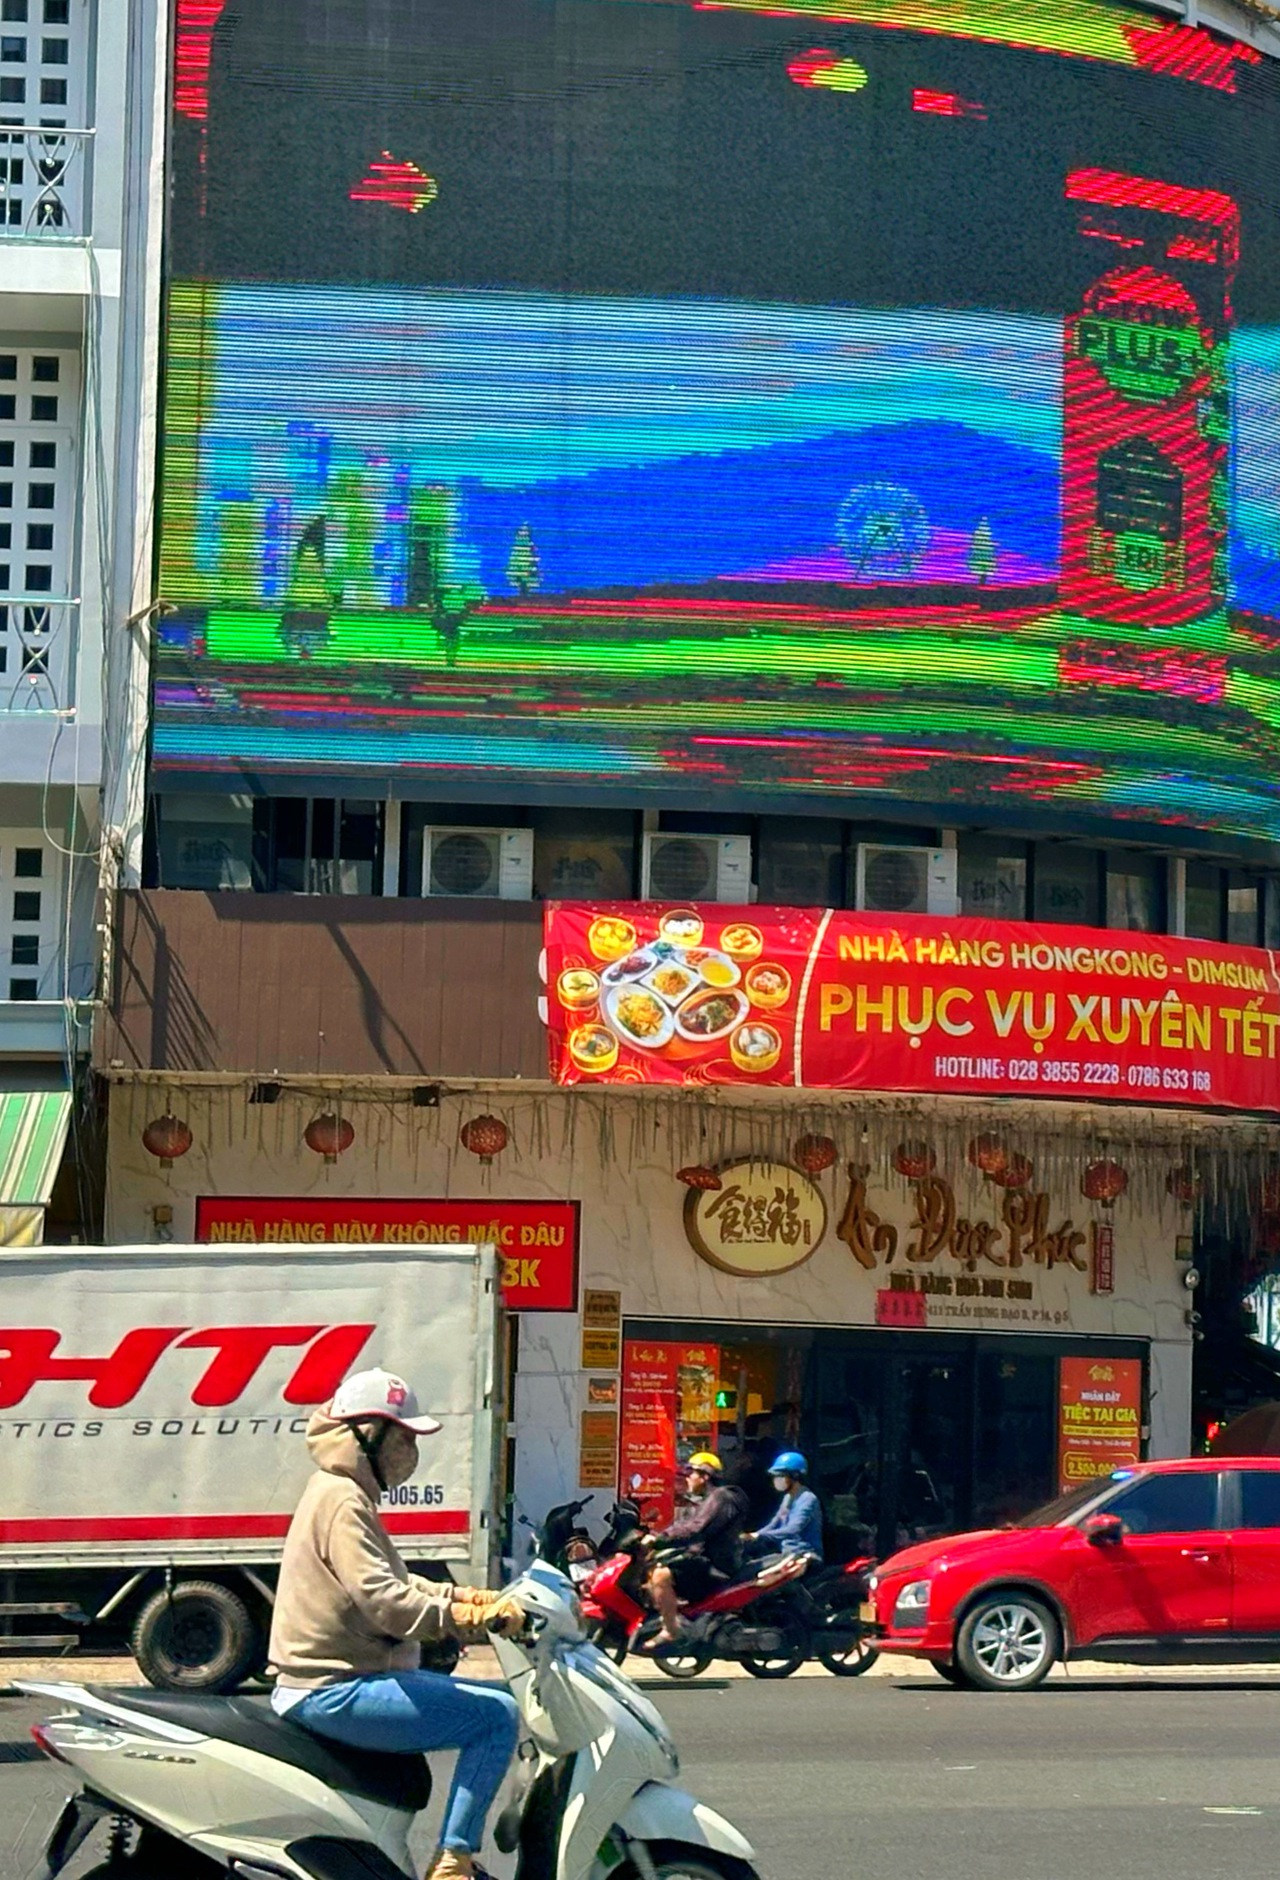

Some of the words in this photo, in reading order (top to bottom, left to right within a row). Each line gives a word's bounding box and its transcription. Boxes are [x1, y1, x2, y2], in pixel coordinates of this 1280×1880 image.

[839, 930, 909, 964] NHÀ
[915, 932, 1005, 968] HÀNG
[1011, 942, 1168, 979] HONGKONG
[1186, 957, 1269, 992] DIMSUM
[820, 983, 975, 1049] PHỤC
[985, 989, 1056, 1054] VỤ
[1066, 989, 1211, 1051] XUYÊN
[935, 1056, 1005, 1080] HOTLINE:
[1008, 1059, 1039, 1081] 028
[1041, 1061, 1080, 1083] 3855
[1083, 1063, 1120, 1085] 2228
[1128, 1065, 1160, 1088] 0786
[1163, 1068, 1189, 1090] 633
[1192, 1071, 1211, 1091] 168
[210, 1217, 257, 1242] NHÀ
[264, 1218, 326, 1242] HÀNG
[383, 1219, 461, 1243] KHÔNG
[520, 1221, 565, 1247] ĐÂU
[501, 1258, 541, 1288] 3K
[0, 1421, 104, 1439] TICS
[132, 1418, 310, 1437] SOLUTIO
[379, 1485, 444, 1506] -005.65
